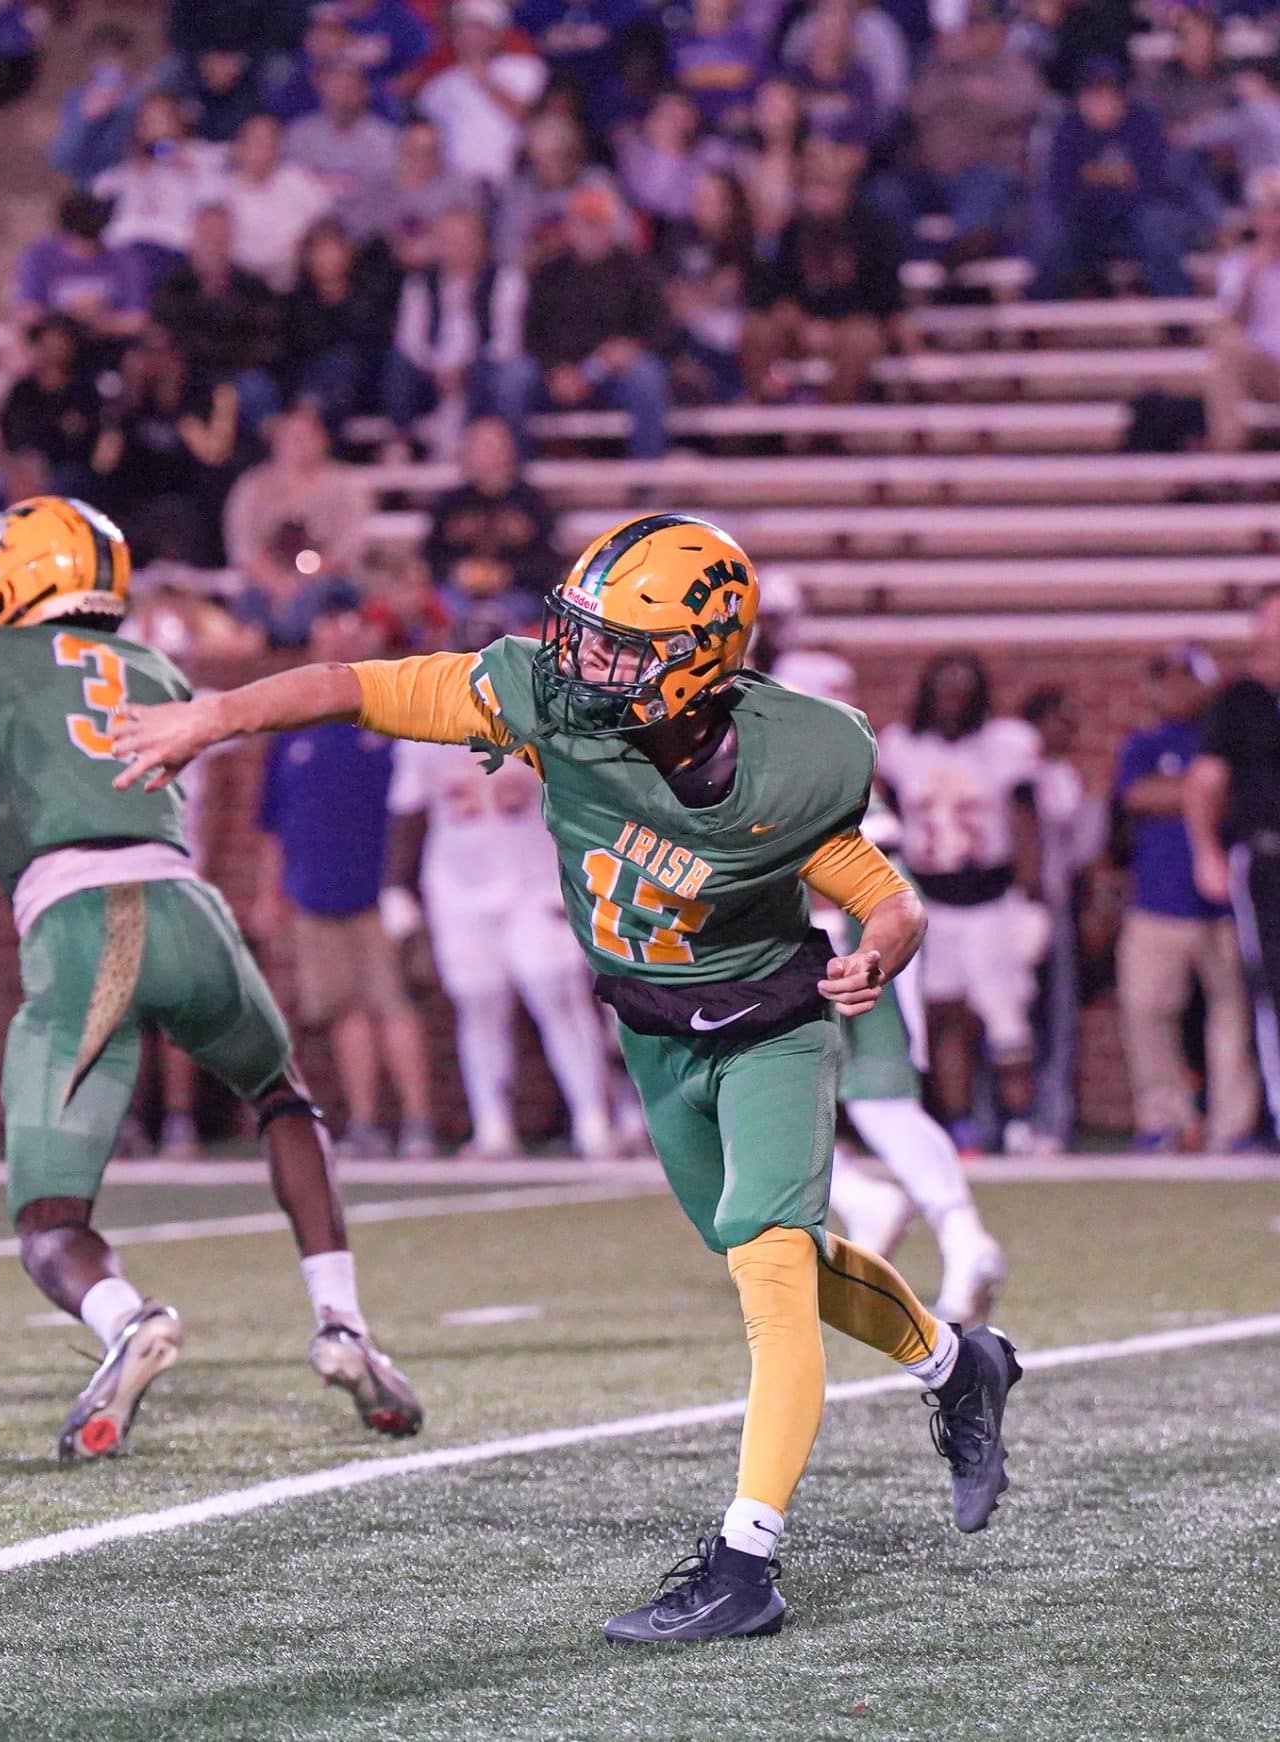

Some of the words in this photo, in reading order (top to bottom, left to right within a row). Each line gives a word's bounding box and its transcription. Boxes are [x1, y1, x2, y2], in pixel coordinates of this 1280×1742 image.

[52, 632, 137, 762] 3
[581, 847, 715, 963] 17
[613, 820, 713, 900] IRISH
